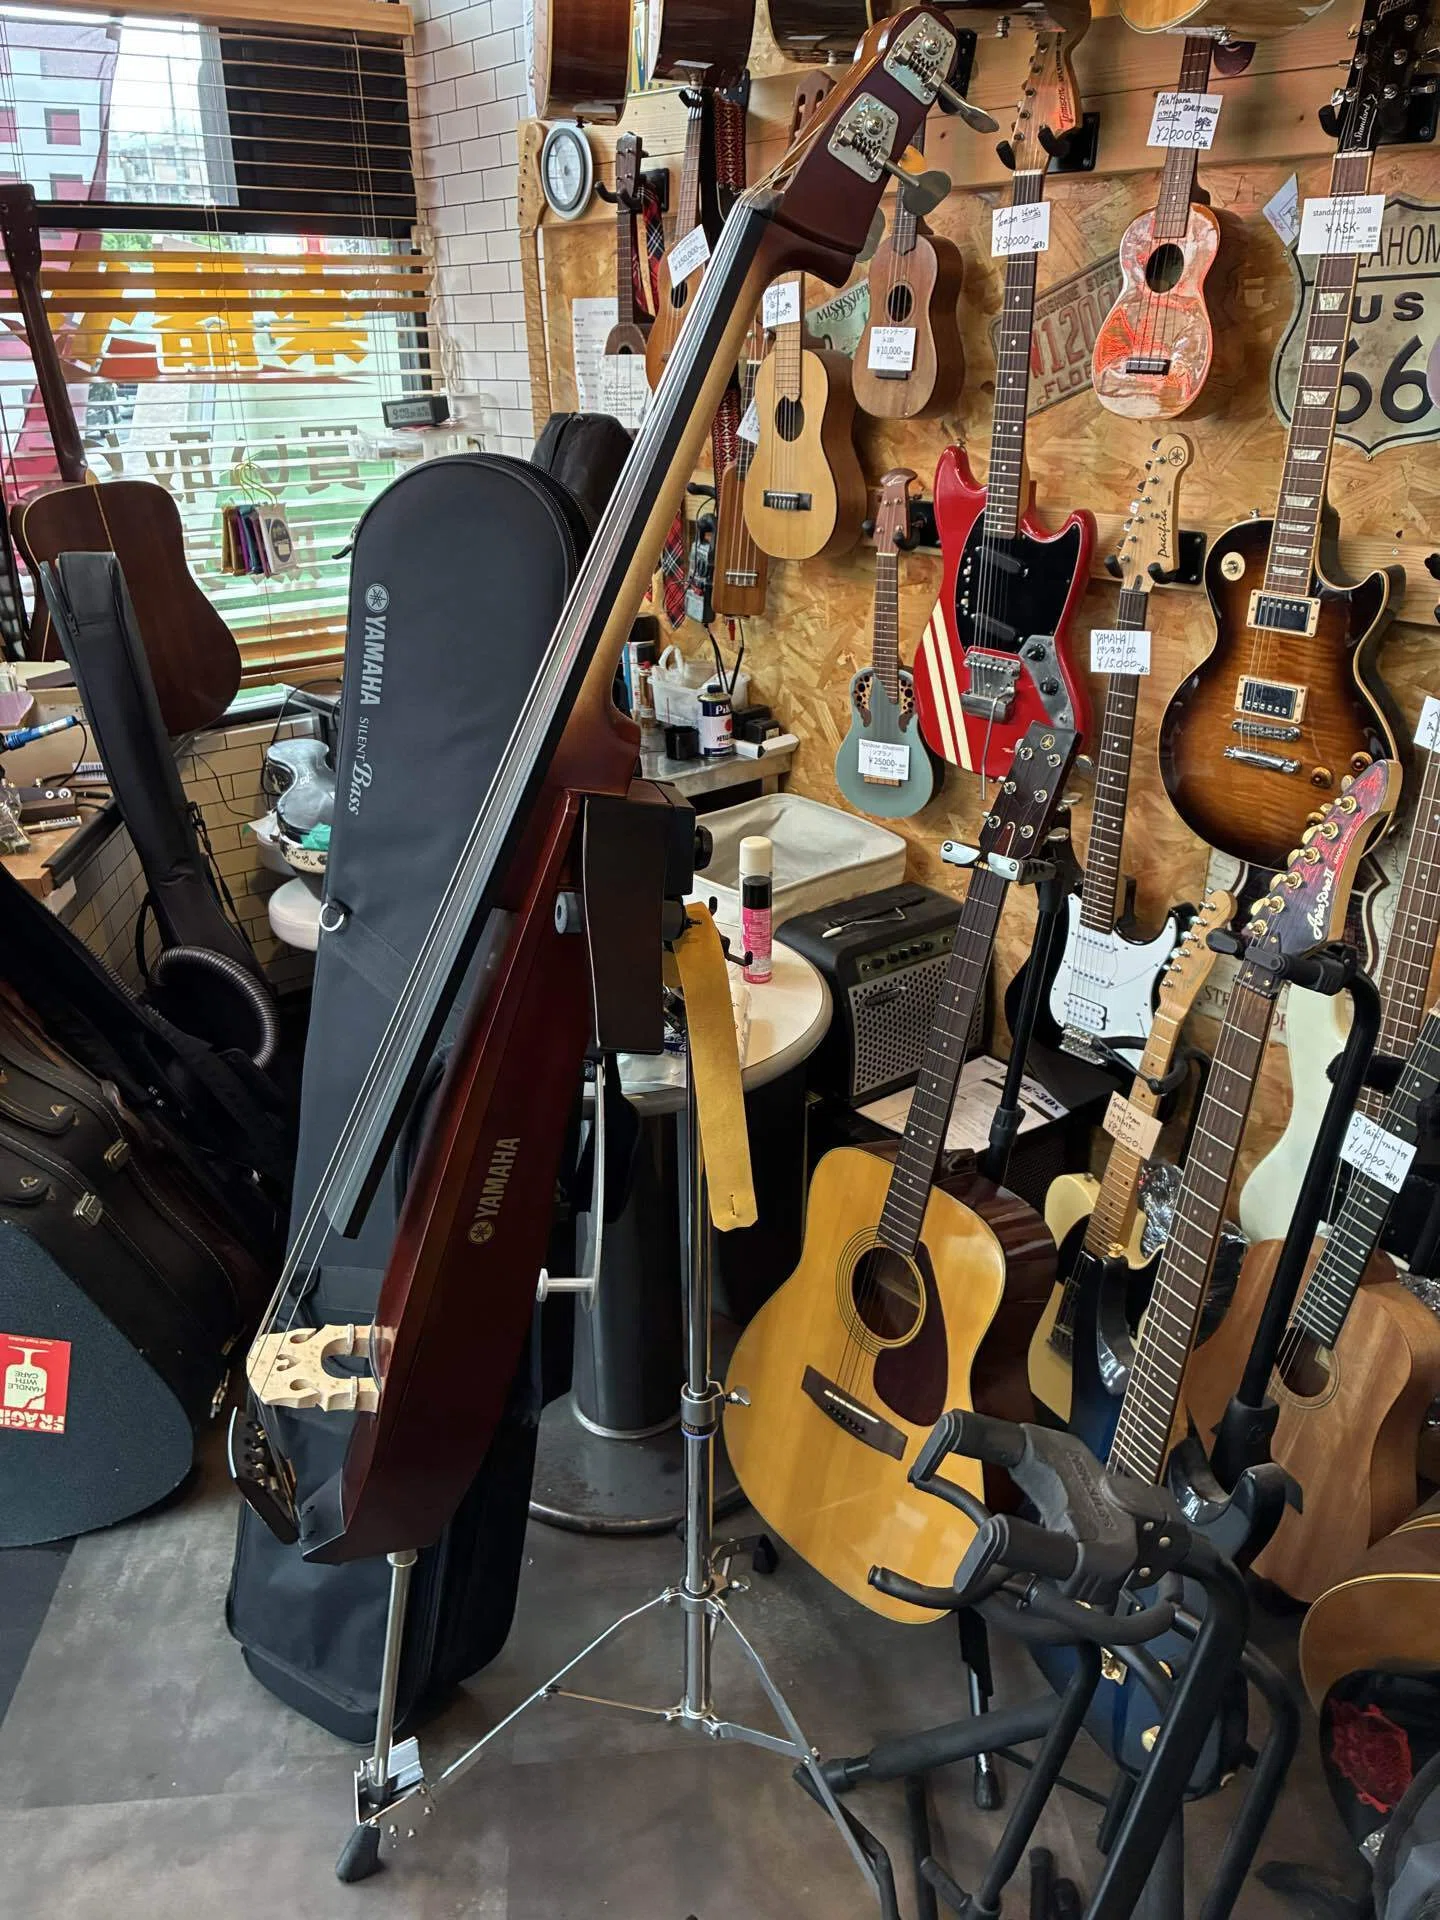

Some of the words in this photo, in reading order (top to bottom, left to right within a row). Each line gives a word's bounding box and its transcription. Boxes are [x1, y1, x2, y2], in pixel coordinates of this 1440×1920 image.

[1354, 102, 1372, 142] Standard
[1356, 206, 1372, 215] 2008
[815, 283, 869, 325] MISSISSIPP
[1335, 335, 1434, 424] 66
[1156, 508, 1171, 559] Pacifica
[360, 614, 387, 705] YAMAHA
[1095, 632, 1126, 645] YAMAHA
[355, 716, 370, 763] SILENT
[347, 760, 374, 816] Bass
[475, 1137, 521, 1219] YAMAHA
[7, 1382, 44, 1393] HANDLE
[15, 1370, 39, 1379] CARE
[15, 1377, 37, 1385] WITH
